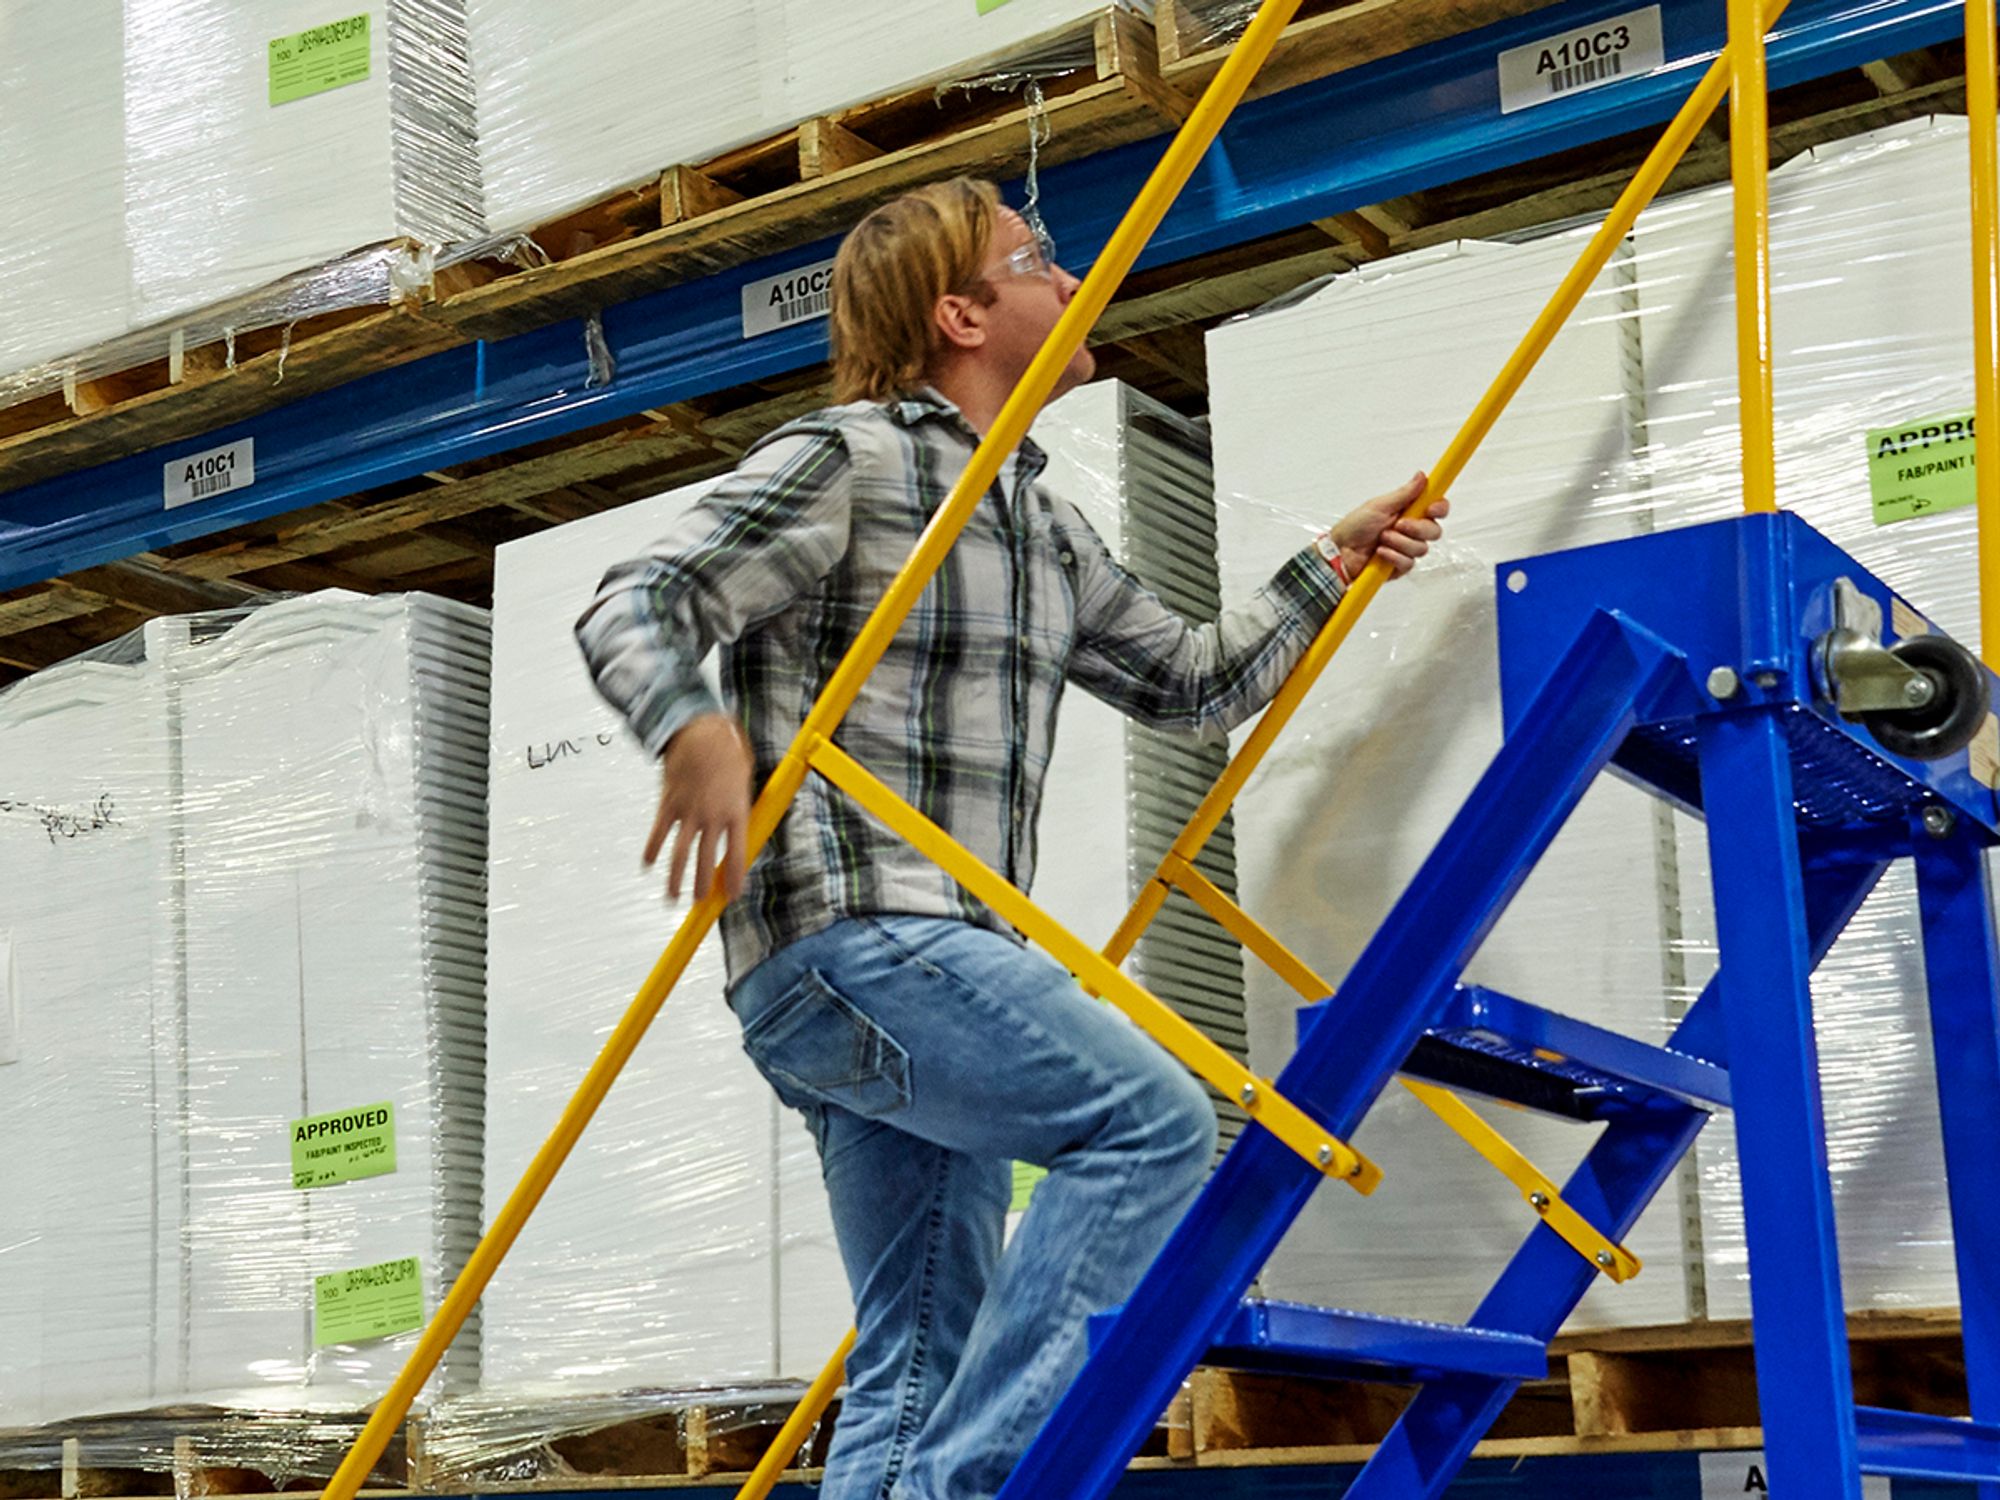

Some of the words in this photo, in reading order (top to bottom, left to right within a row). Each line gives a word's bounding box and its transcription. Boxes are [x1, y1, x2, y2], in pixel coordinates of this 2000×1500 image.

[276, 49, 292, 61] 100
[1536, 25, 1630, 75] A10C3
[1877, 417, 1976, 459] APPR
[184, 450, 235, 483] A10C1
[1897, 456, 1965, 481] FAB/PAINT
[295, 1109, 388, 1142] APPROVED
[344, 1136, 382, 1152] INSPECTED
